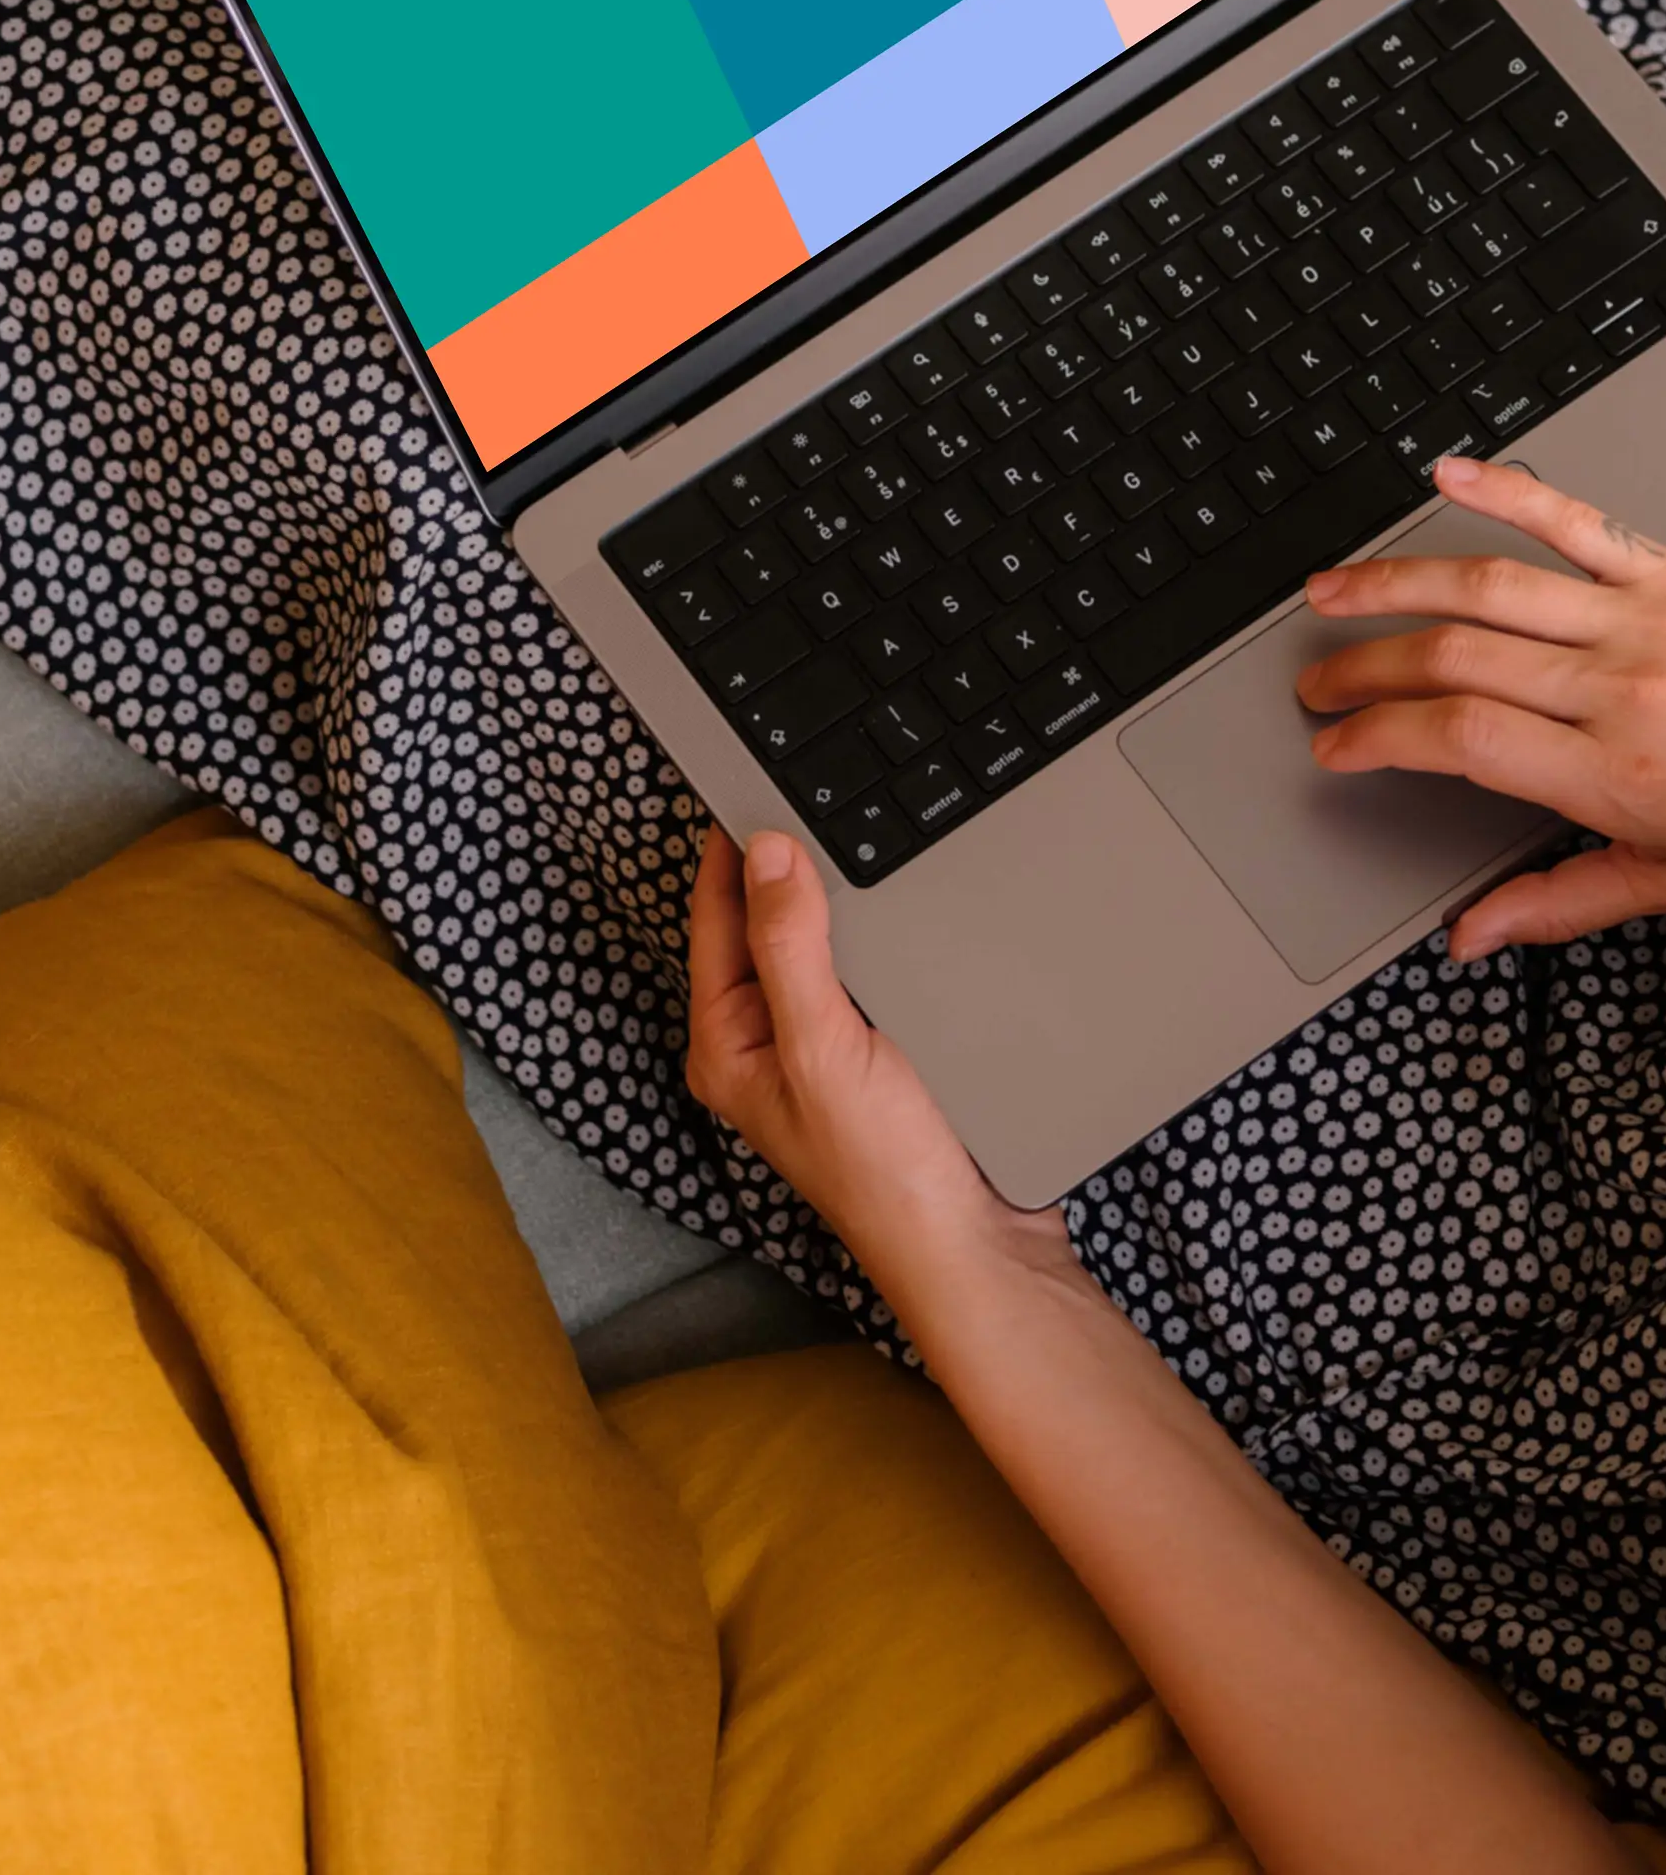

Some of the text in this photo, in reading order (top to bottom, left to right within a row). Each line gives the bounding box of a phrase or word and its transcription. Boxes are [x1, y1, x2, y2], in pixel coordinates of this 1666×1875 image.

[1296, 200, 1311, 218] é
[1427, 195, 1444, 214] ú
[1222, 224, 1235, 238] 9
[1359, 226, 1374, 244] P
[1163, 263, 1177, 278] 8
[1179, 279, 1194, 298] á
[1103, 303, 1115, 317] 7
[1360, 313, 1379, 327] L
[1045, 344, 1058, 357] 6
[1182, 345, 1201, 364] U
[1301, 349, 1320, 368] K
[985, 383, 998, 398] 5
[1123, 385, 1142, 405] Z
[1247, 391, 1259, 408] J
[1493, 396, 1530, 425] option
[927, 424, 938, 437] 4
[1063, 426, 1079, 443] T
[1314, 423, 1336, 444] M
[1181, 430, 1201, 450] H
[1418, 431, 1474, 478] comand
[864, 465, 877, 479] 3
[1004, 467, 1023, 485] R
[1123, 472, 1141, 490] G
[1256, 465, 1276, 484] N
[803, 506, 817, 520] 2
[944, 508, 962, 527] E
[1063, 512, 1077, 531] F
[1197, 507, 1215, 525] B
[743, 548, 754, 560] 1
[879, 547, 901, 568] W
[1135, 547, 1152, 565] V
[642, 559, 665, 578] esc
[1002, 554, 1020, 573] D
[822, 591, 841, 609] Q
[942, 595, 959, 613] S
[1077, 589, 1095, 607] C
[883, 638, 900, 656] A
[1015, 630, 1035, 650] X
[954, 672, 970, 689] Y
[1044, 691, 1101, 736] command
[986, 746, 1024, 776] option
[864, 806, 881, 819] fn
[921, 787, 963, 821] control
